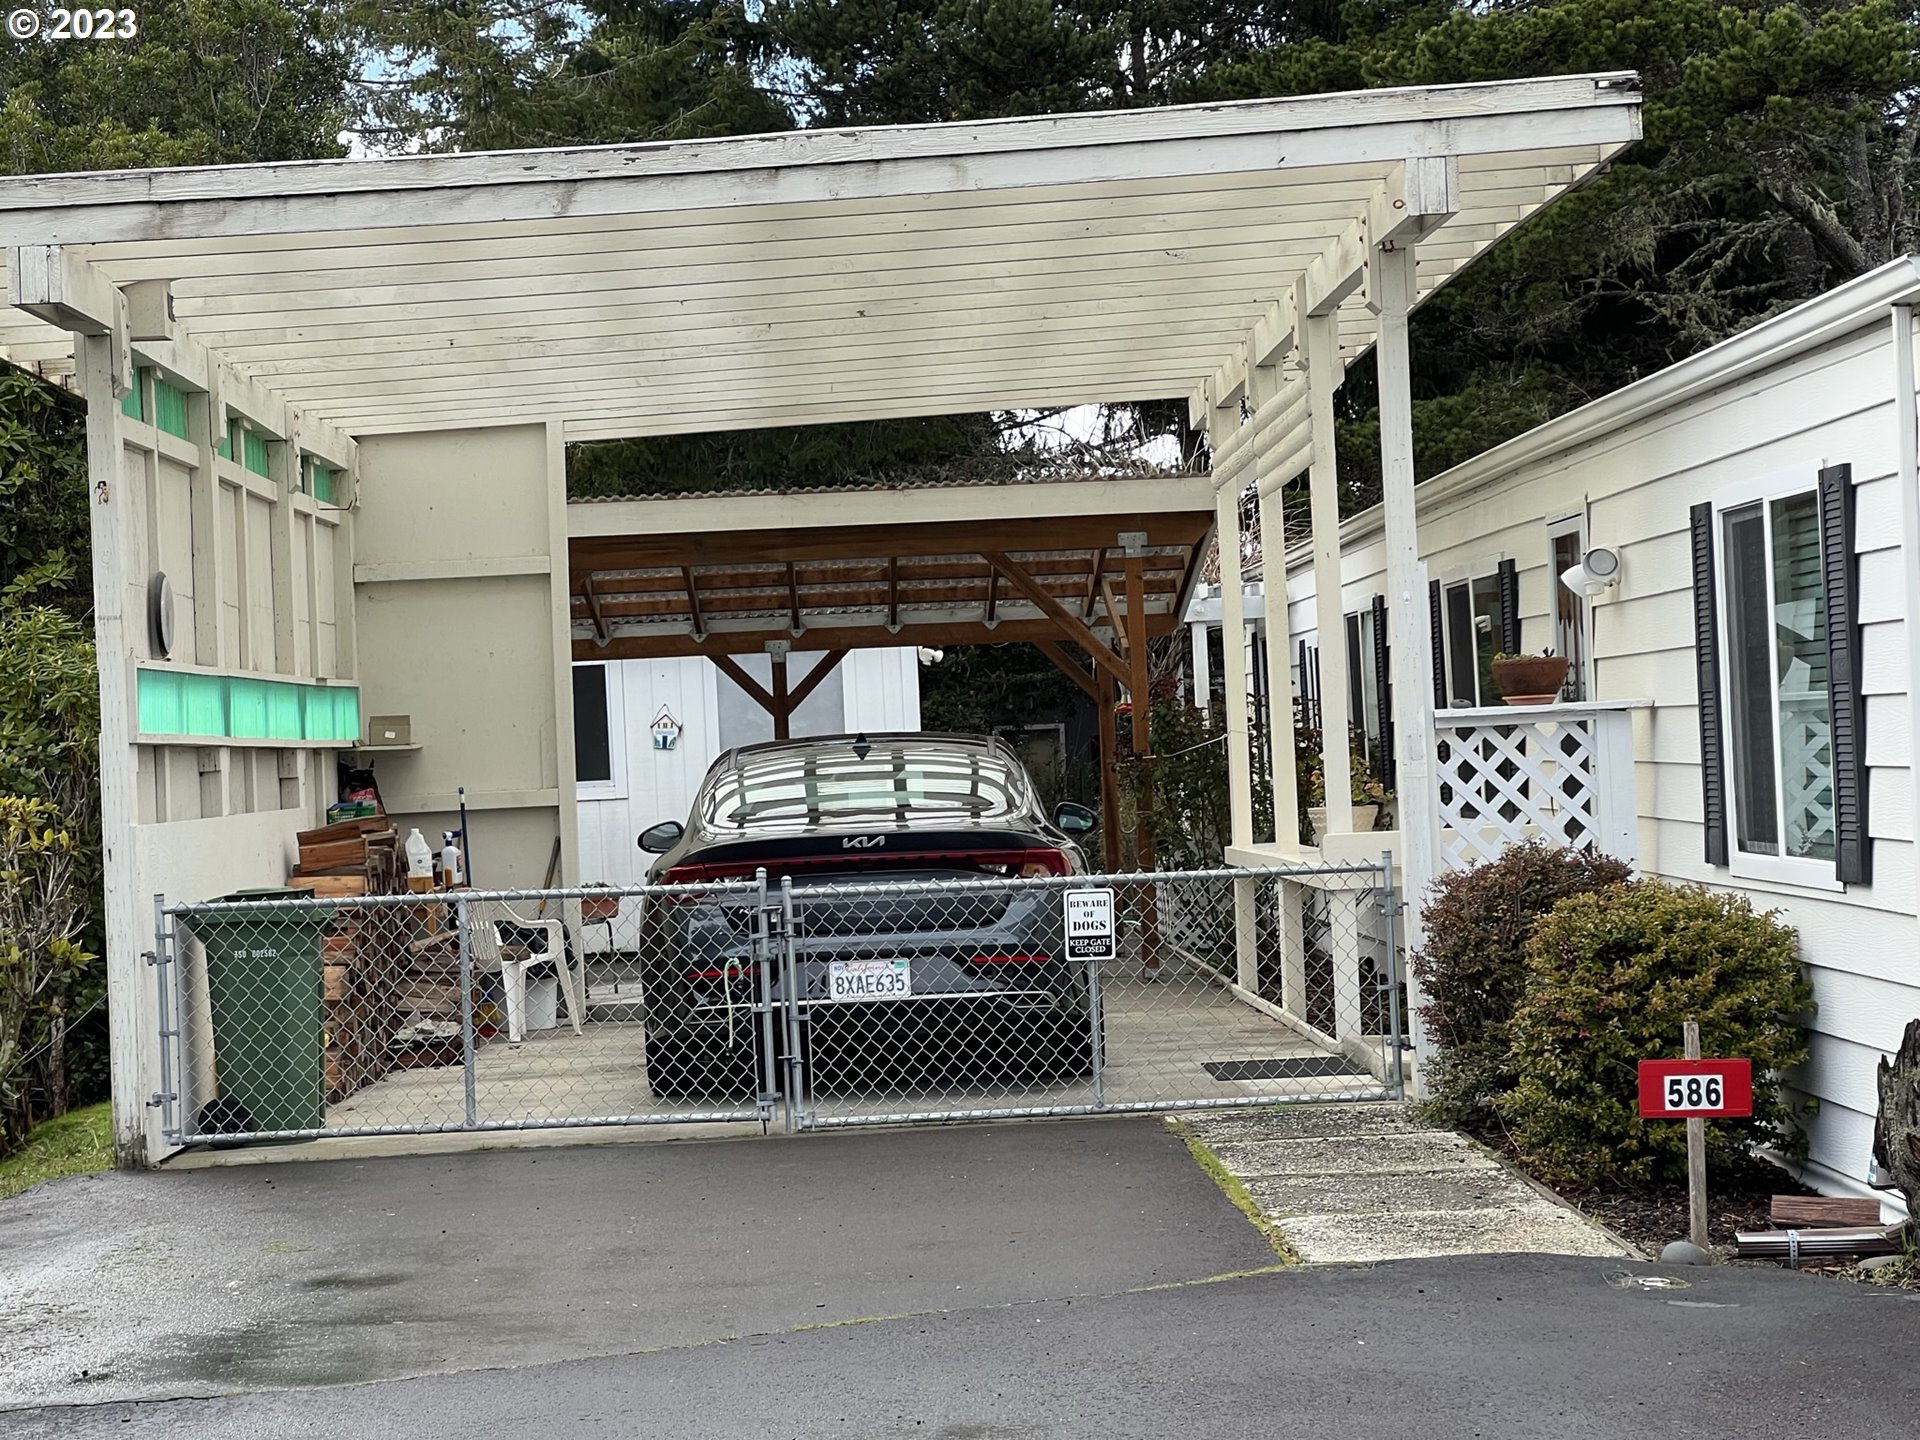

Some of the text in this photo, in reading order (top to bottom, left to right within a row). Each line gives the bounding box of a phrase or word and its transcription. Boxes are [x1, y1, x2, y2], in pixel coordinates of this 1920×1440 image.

[842, 835, 885, 849] KIA
[1070, 900, 1108, 908] BEWARE
[1073, 920, 1107, 931] DOGS
[835, 973, 905, 995] 8XAE635
[1668, 1078, 1721, 1108] 586
